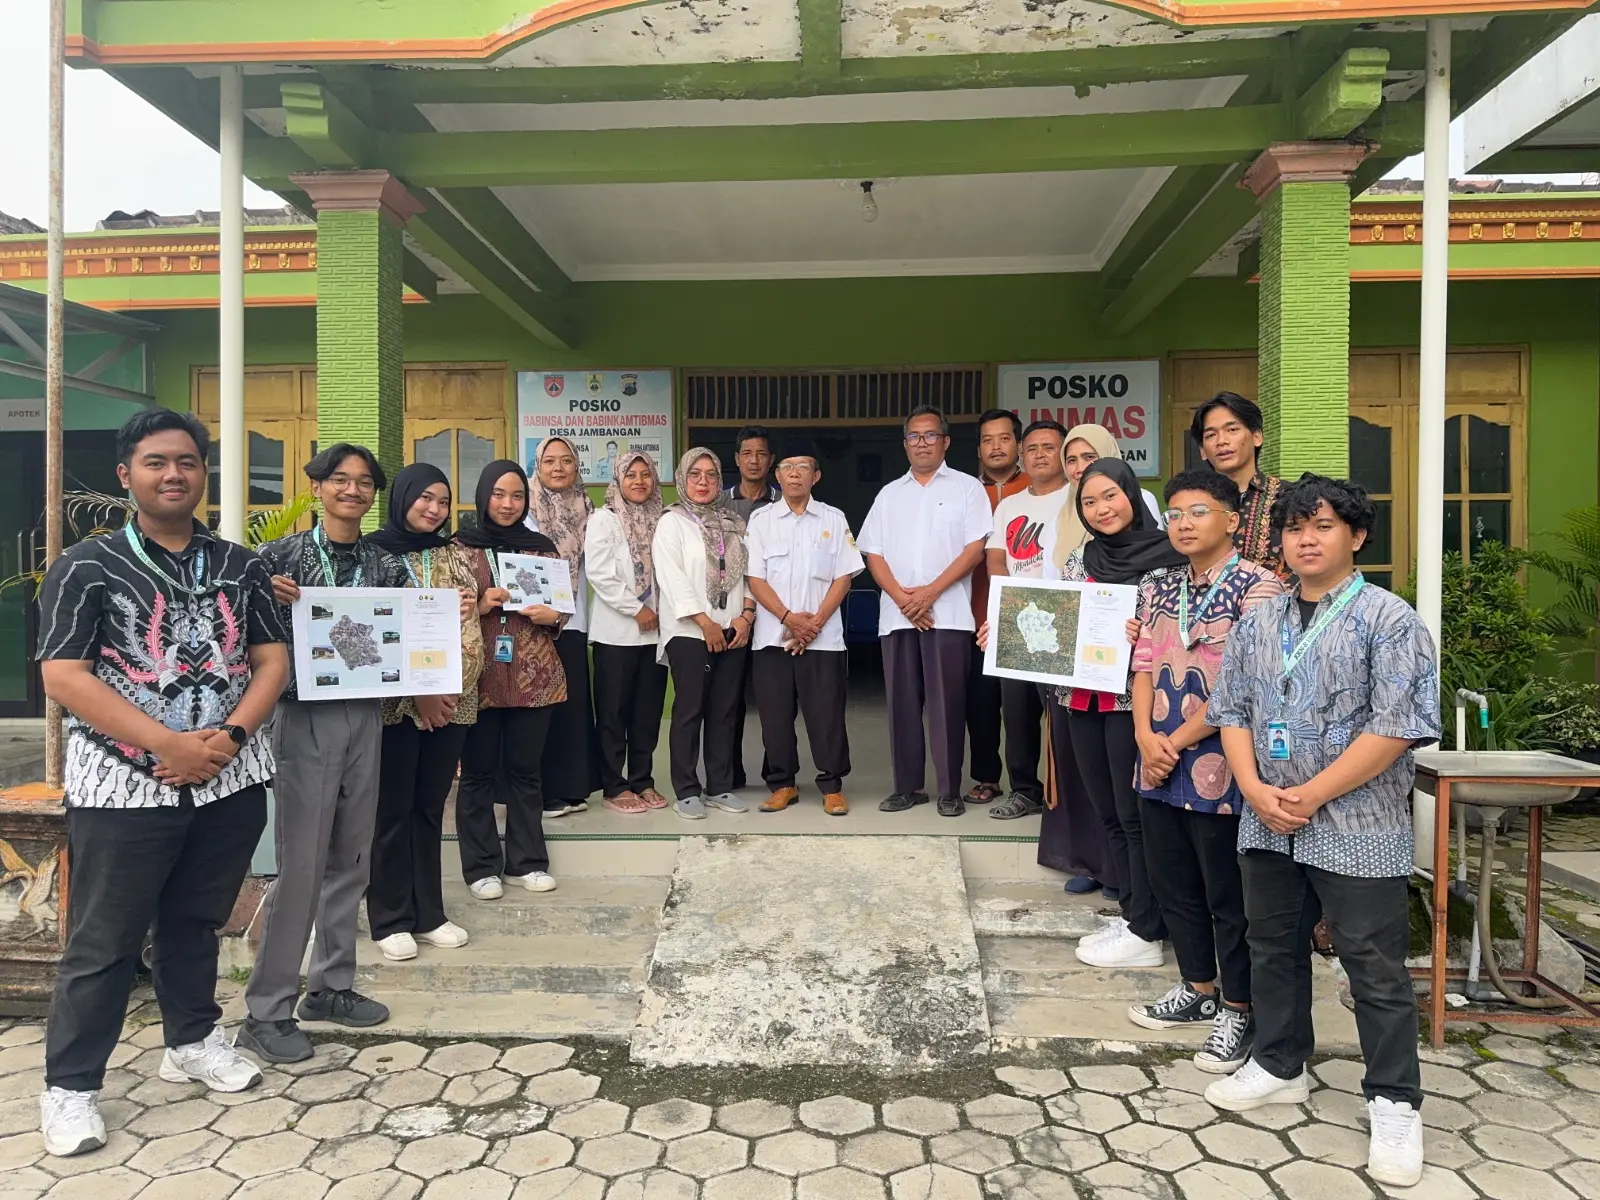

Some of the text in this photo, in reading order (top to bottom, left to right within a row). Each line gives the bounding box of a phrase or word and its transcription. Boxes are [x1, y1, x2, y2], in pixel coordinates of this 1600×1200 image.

[1028, 374, 1129, 400] POSKO
[569, 399, 621, 412] POSKO
[8, 410, 41, 418] APOTEK
[523, 414, 667, 427] BABINSA DAN BABINKAMTIBMAS
[549, 427, 641, 437] DESA JAMBANGAN
